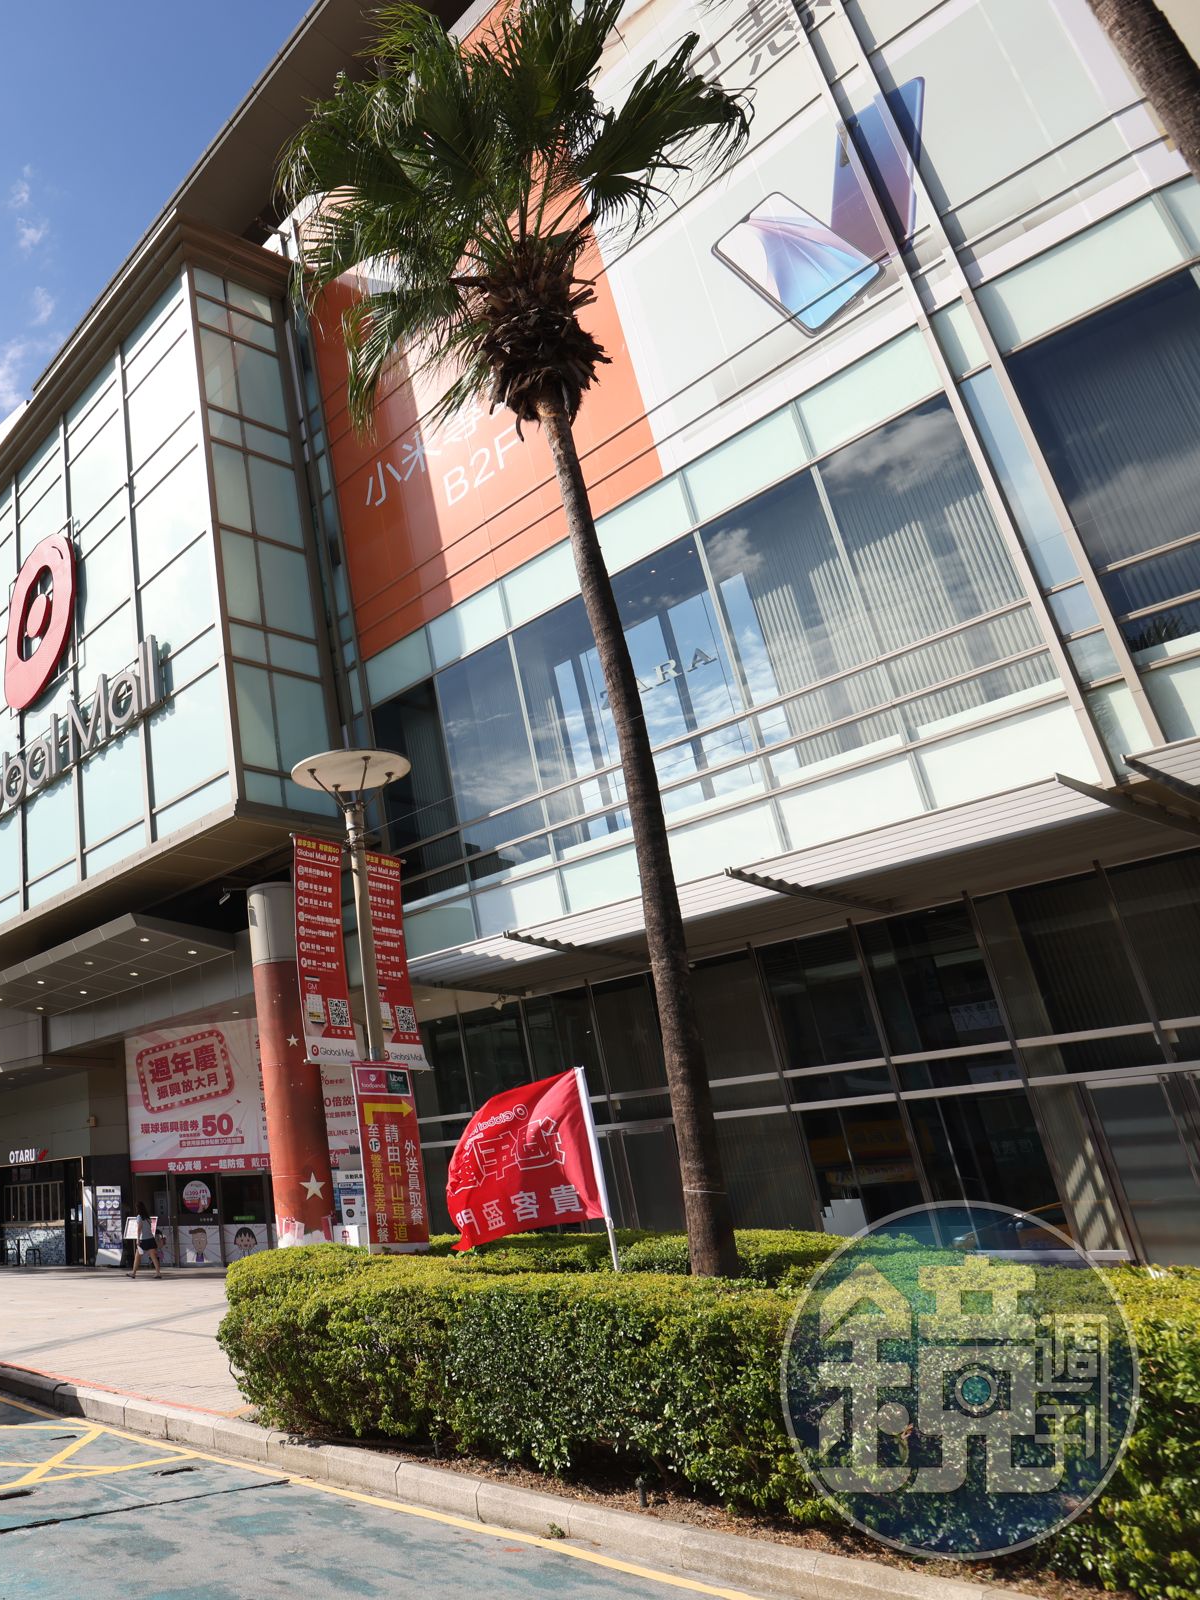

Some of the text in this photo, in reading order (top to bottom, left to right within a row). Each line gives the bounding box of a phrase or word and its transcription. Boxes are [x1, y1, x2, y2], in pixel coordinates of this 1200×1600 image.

[443, 424, 520, 506] B2F
[67, 634, 161, 771] Mall
[297, 848, 339, 863] Global Mall APP
[319, 1047, 355, 1058] Global Mall
[390, 1051, 423, 1062] Global Mall
[147, 1043, 218, 1084] 週年慶
[156, 1072, 218, 1100] 振興放大月
[389, 1073, 404, 1082] Uber
[324, 1096, 355, 1107] 0倍放
[9, 1149, 35, 1163] OTARU
[384, 1124, 409, 1242] 請由中山車道
[404, 1140, 424, 1226] 外送員取餐
